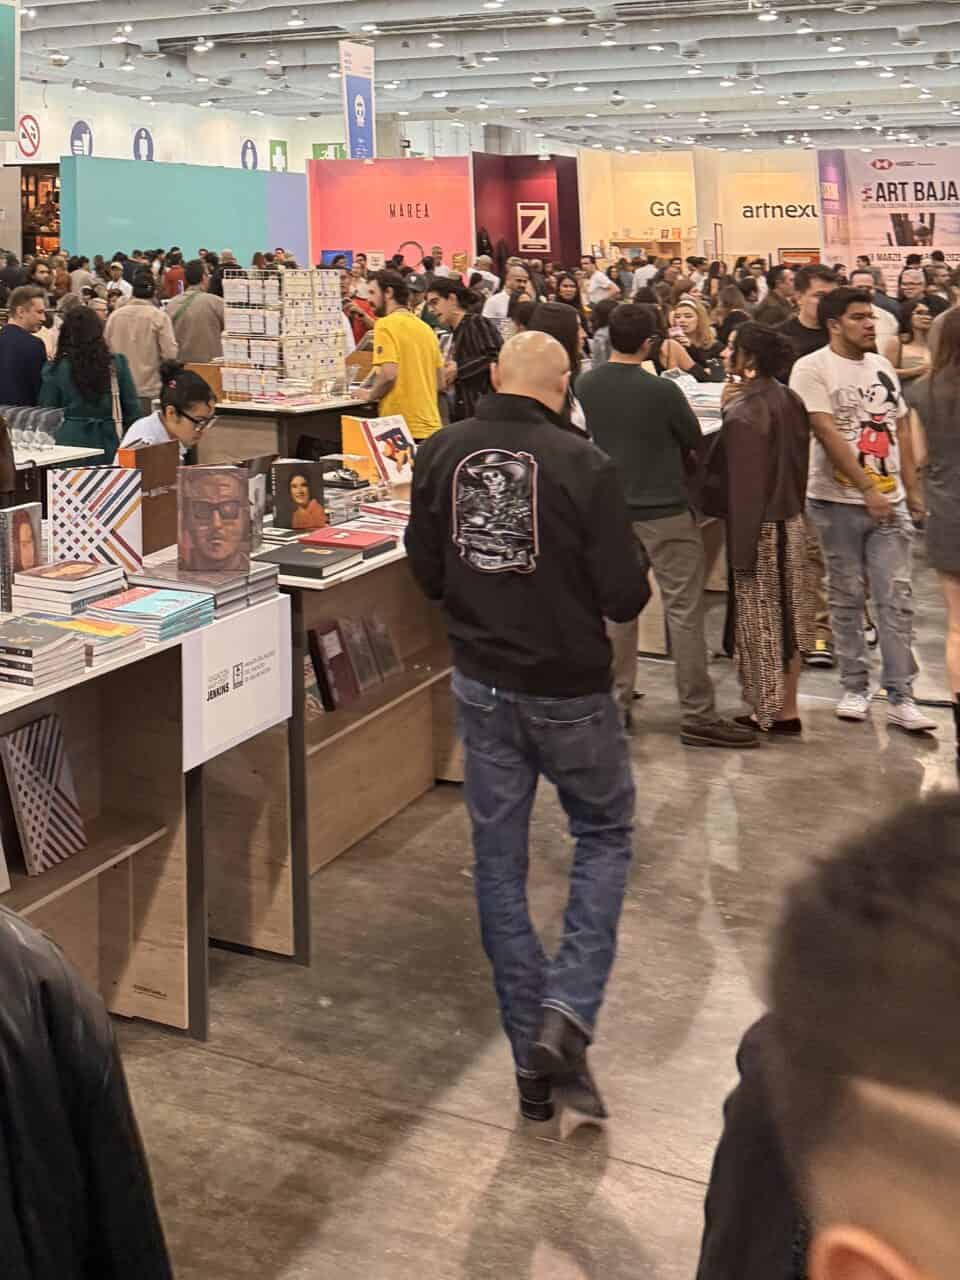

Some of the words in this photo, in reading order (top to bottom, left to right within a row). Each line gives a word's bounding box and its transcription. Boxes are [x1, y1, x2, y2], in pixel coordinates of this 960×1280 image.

[876, 182, 908, 202] ART
[914, 180, 959, 201] BAJA
[389, 203, 431, 219] MAREA
[649, 201, 681, 217] GG
[206, 681, 229, 702] JENKINS
